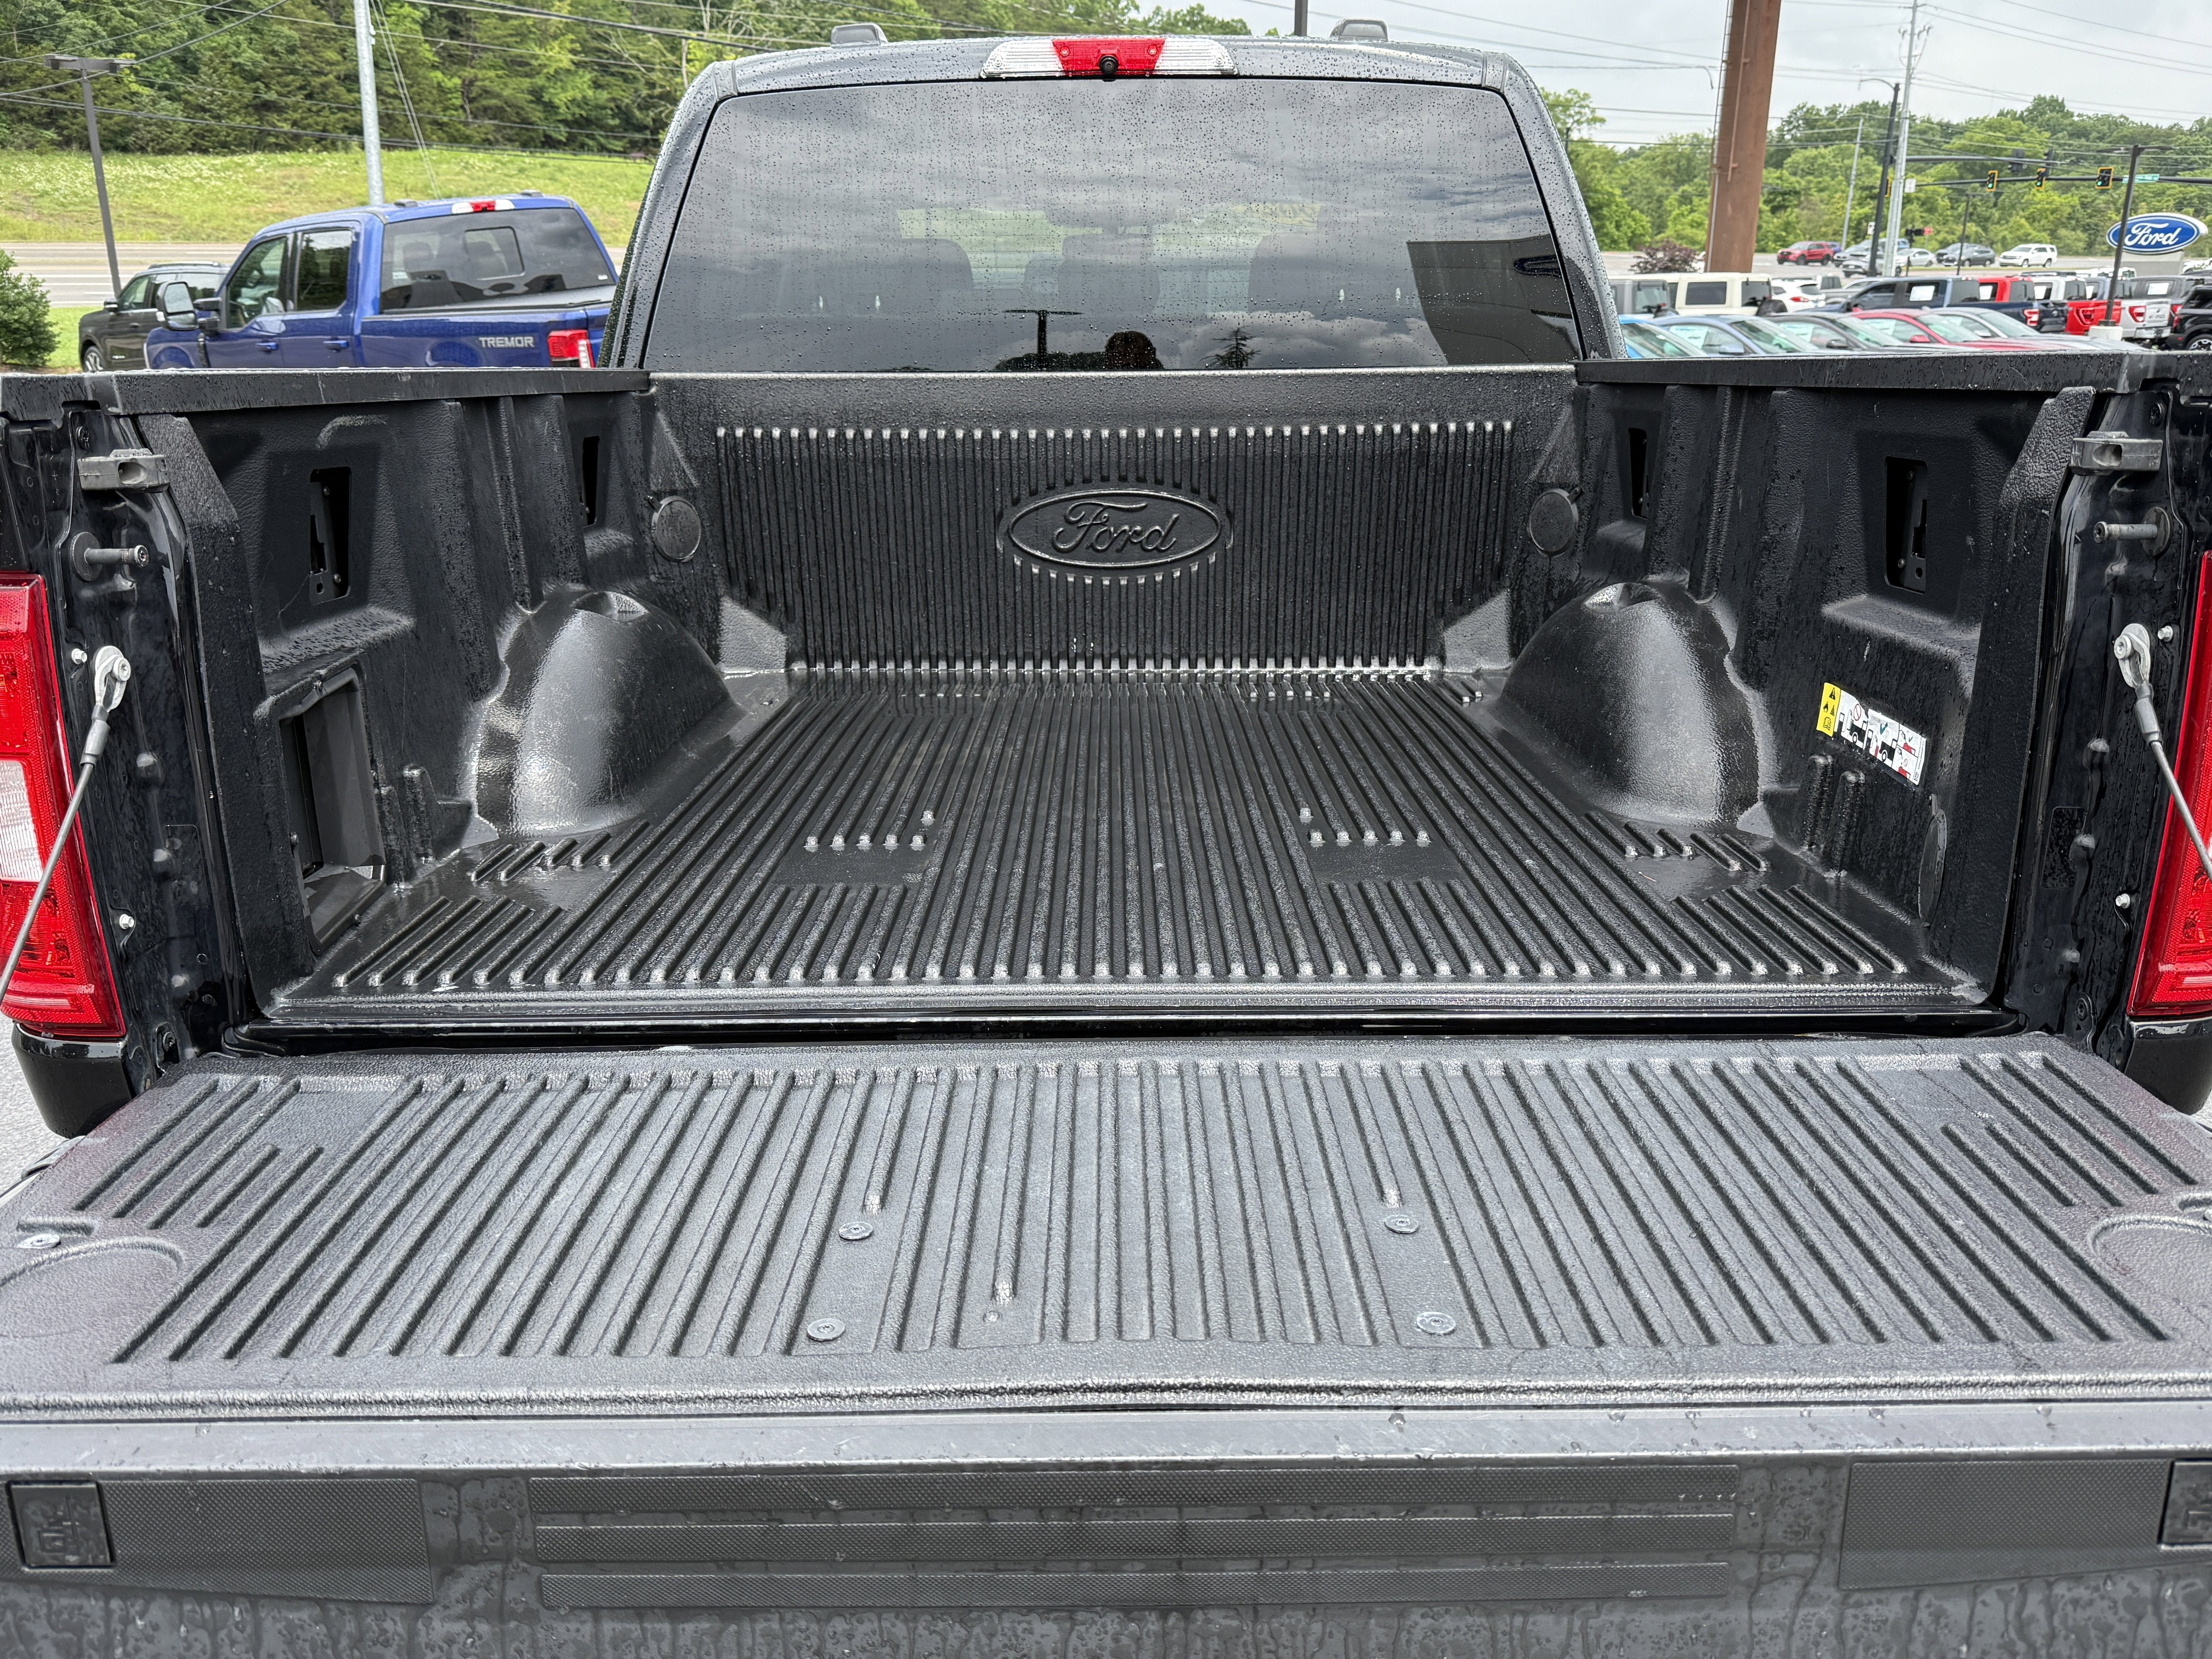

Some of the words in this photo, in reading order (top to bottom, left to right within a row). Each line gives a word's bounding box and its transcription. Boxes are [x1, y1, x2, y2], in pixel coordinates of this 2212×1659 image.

[2124, 223, 2182, 246] Ford
[479, 336, 535, 348] TREMOR
[1052, 500, 1179, 553] Ford
